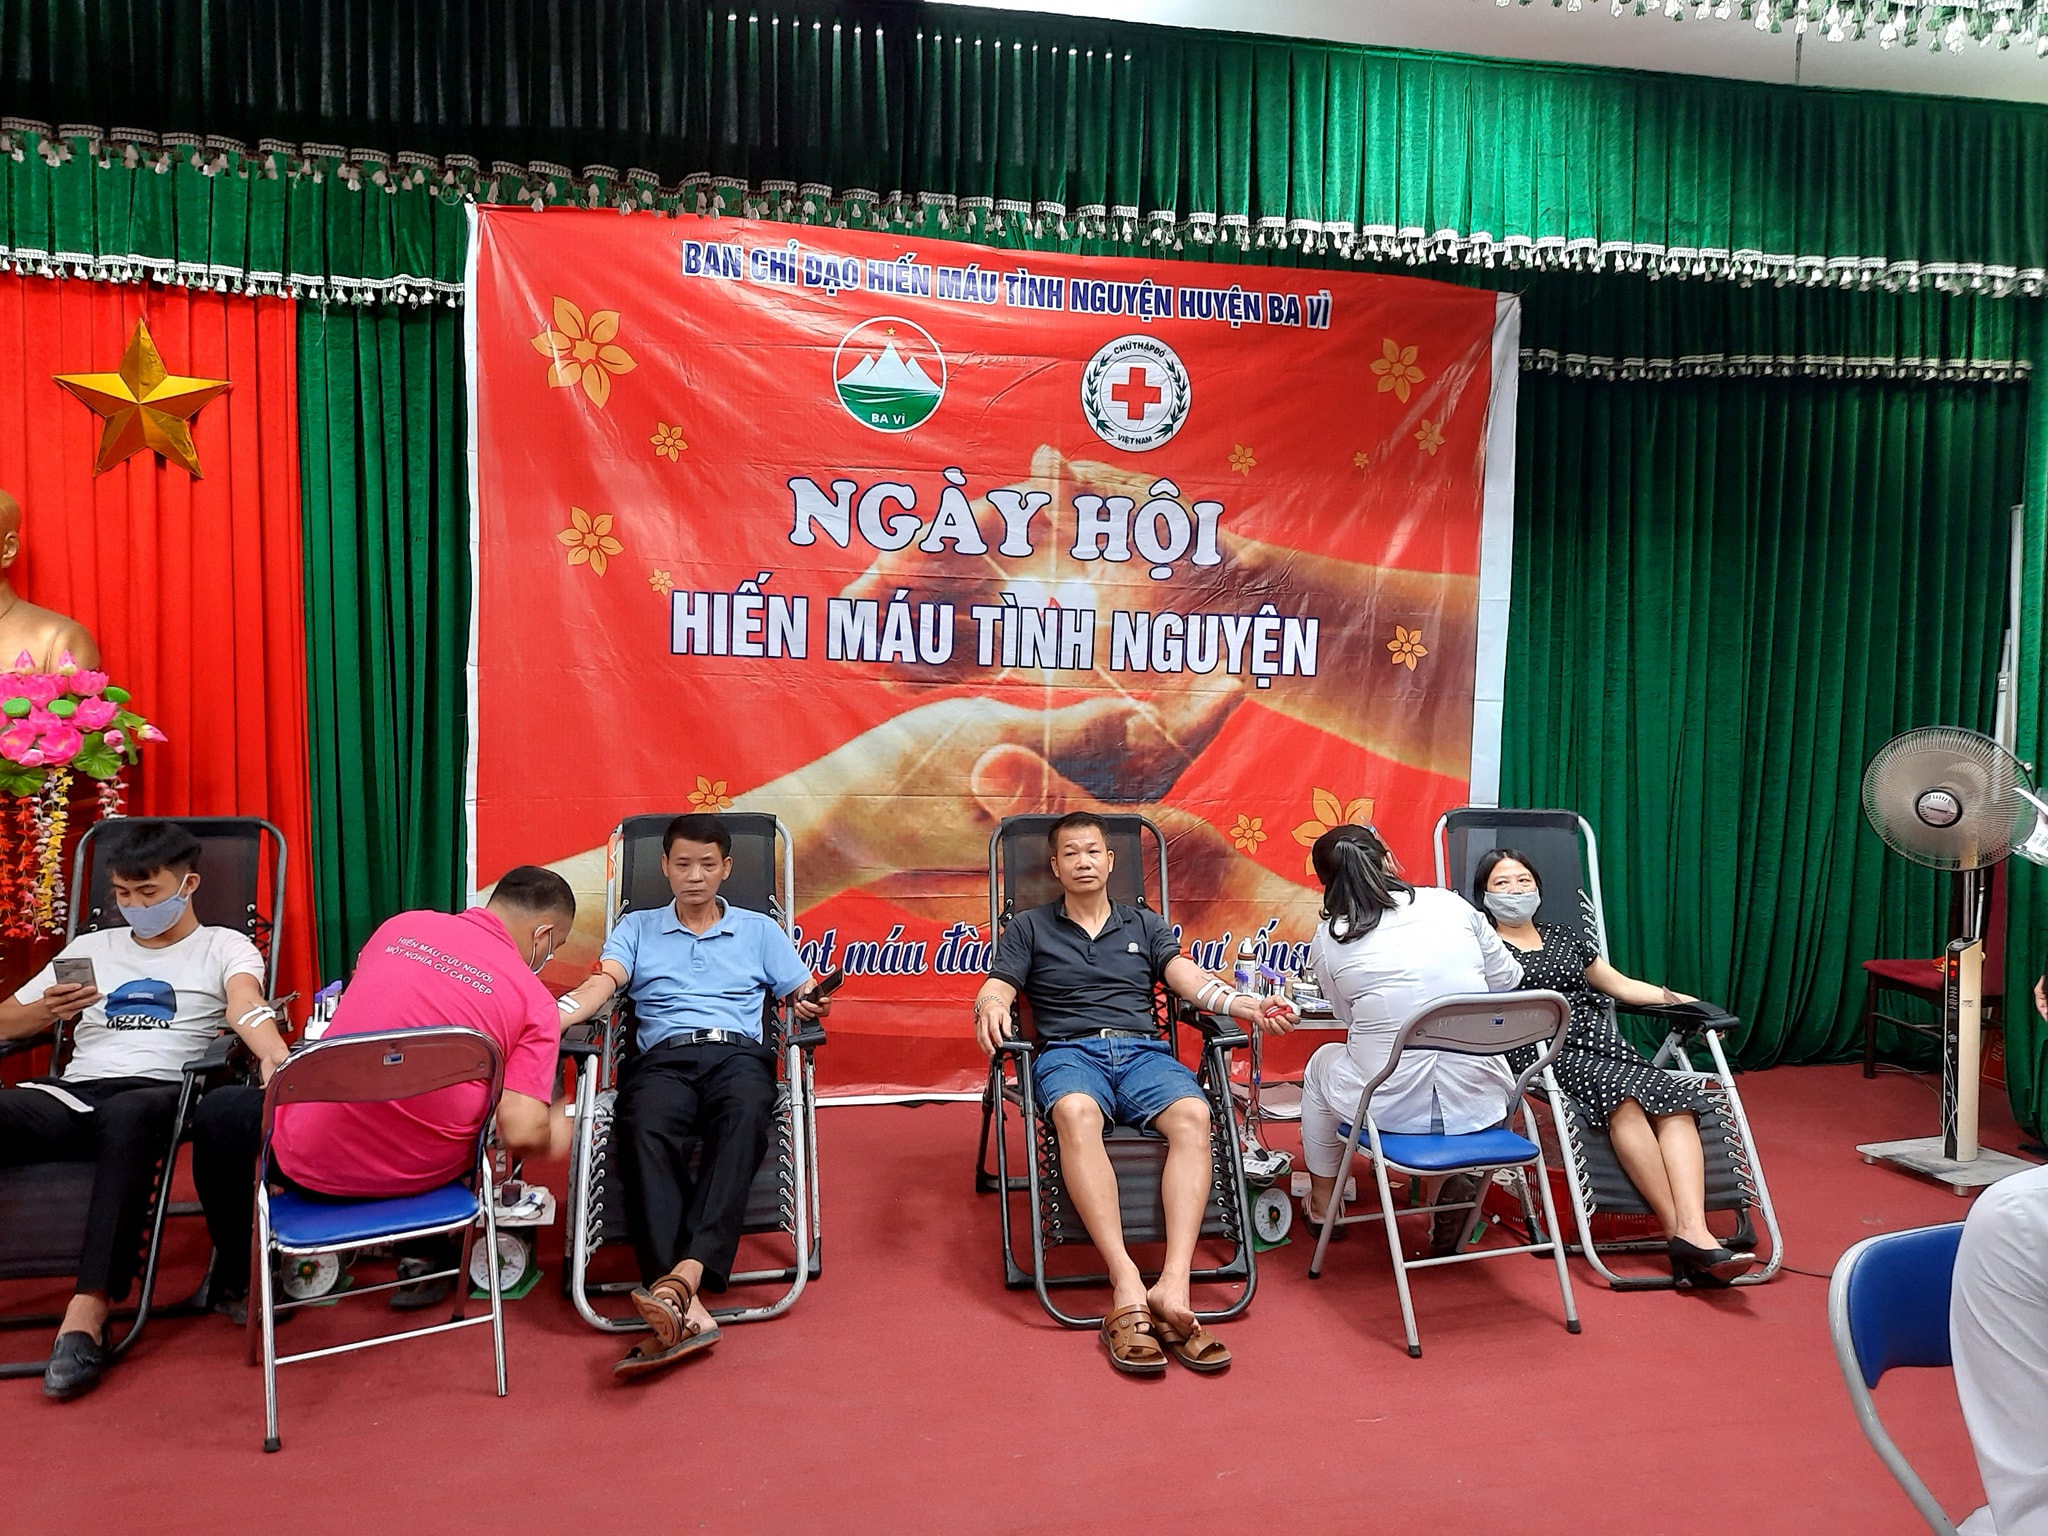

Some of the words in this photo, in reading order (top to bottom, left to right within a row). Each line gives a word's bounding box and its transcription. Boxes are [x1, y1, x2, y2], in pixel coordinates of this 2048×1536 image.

[682, 239, 743, 281] BAN
[750, 238, 798, 287] CHỈ
[802, 254, 860, 296] ĐẠO
[866, 252, 932, 298] HIẾN
[936, 263, 998, 305] MÁU
[1002, 267, 1065, 310] TÌNH
[1069, 278, 1174, 323] NGUYỆN
[1178, 282, 1263, 328] HUYỆN
[1266, 291, 1302, 328] BA
[1305, 289, 1333, 330] VÌ
[871, 413, 889, 424] BA
[892, 413, 906, 425] VÌ
[787, 466, 1053, 559] NGÀY
[1069, 478, 1225, 580] HỘI
[671, 571, 808, 659] HIẾN
[826, 587, 956, 665] MÁU
[971, 590, 1098, 670] TÌNH
[1110, 603, 1321, 689] NGUYỆN
[418, 944, 441, 958] MÁU
[844, 924, 928, 976] máu
[449, 970, 472, 983] CAO
[471, 980, 493, 994] ĐẸP
